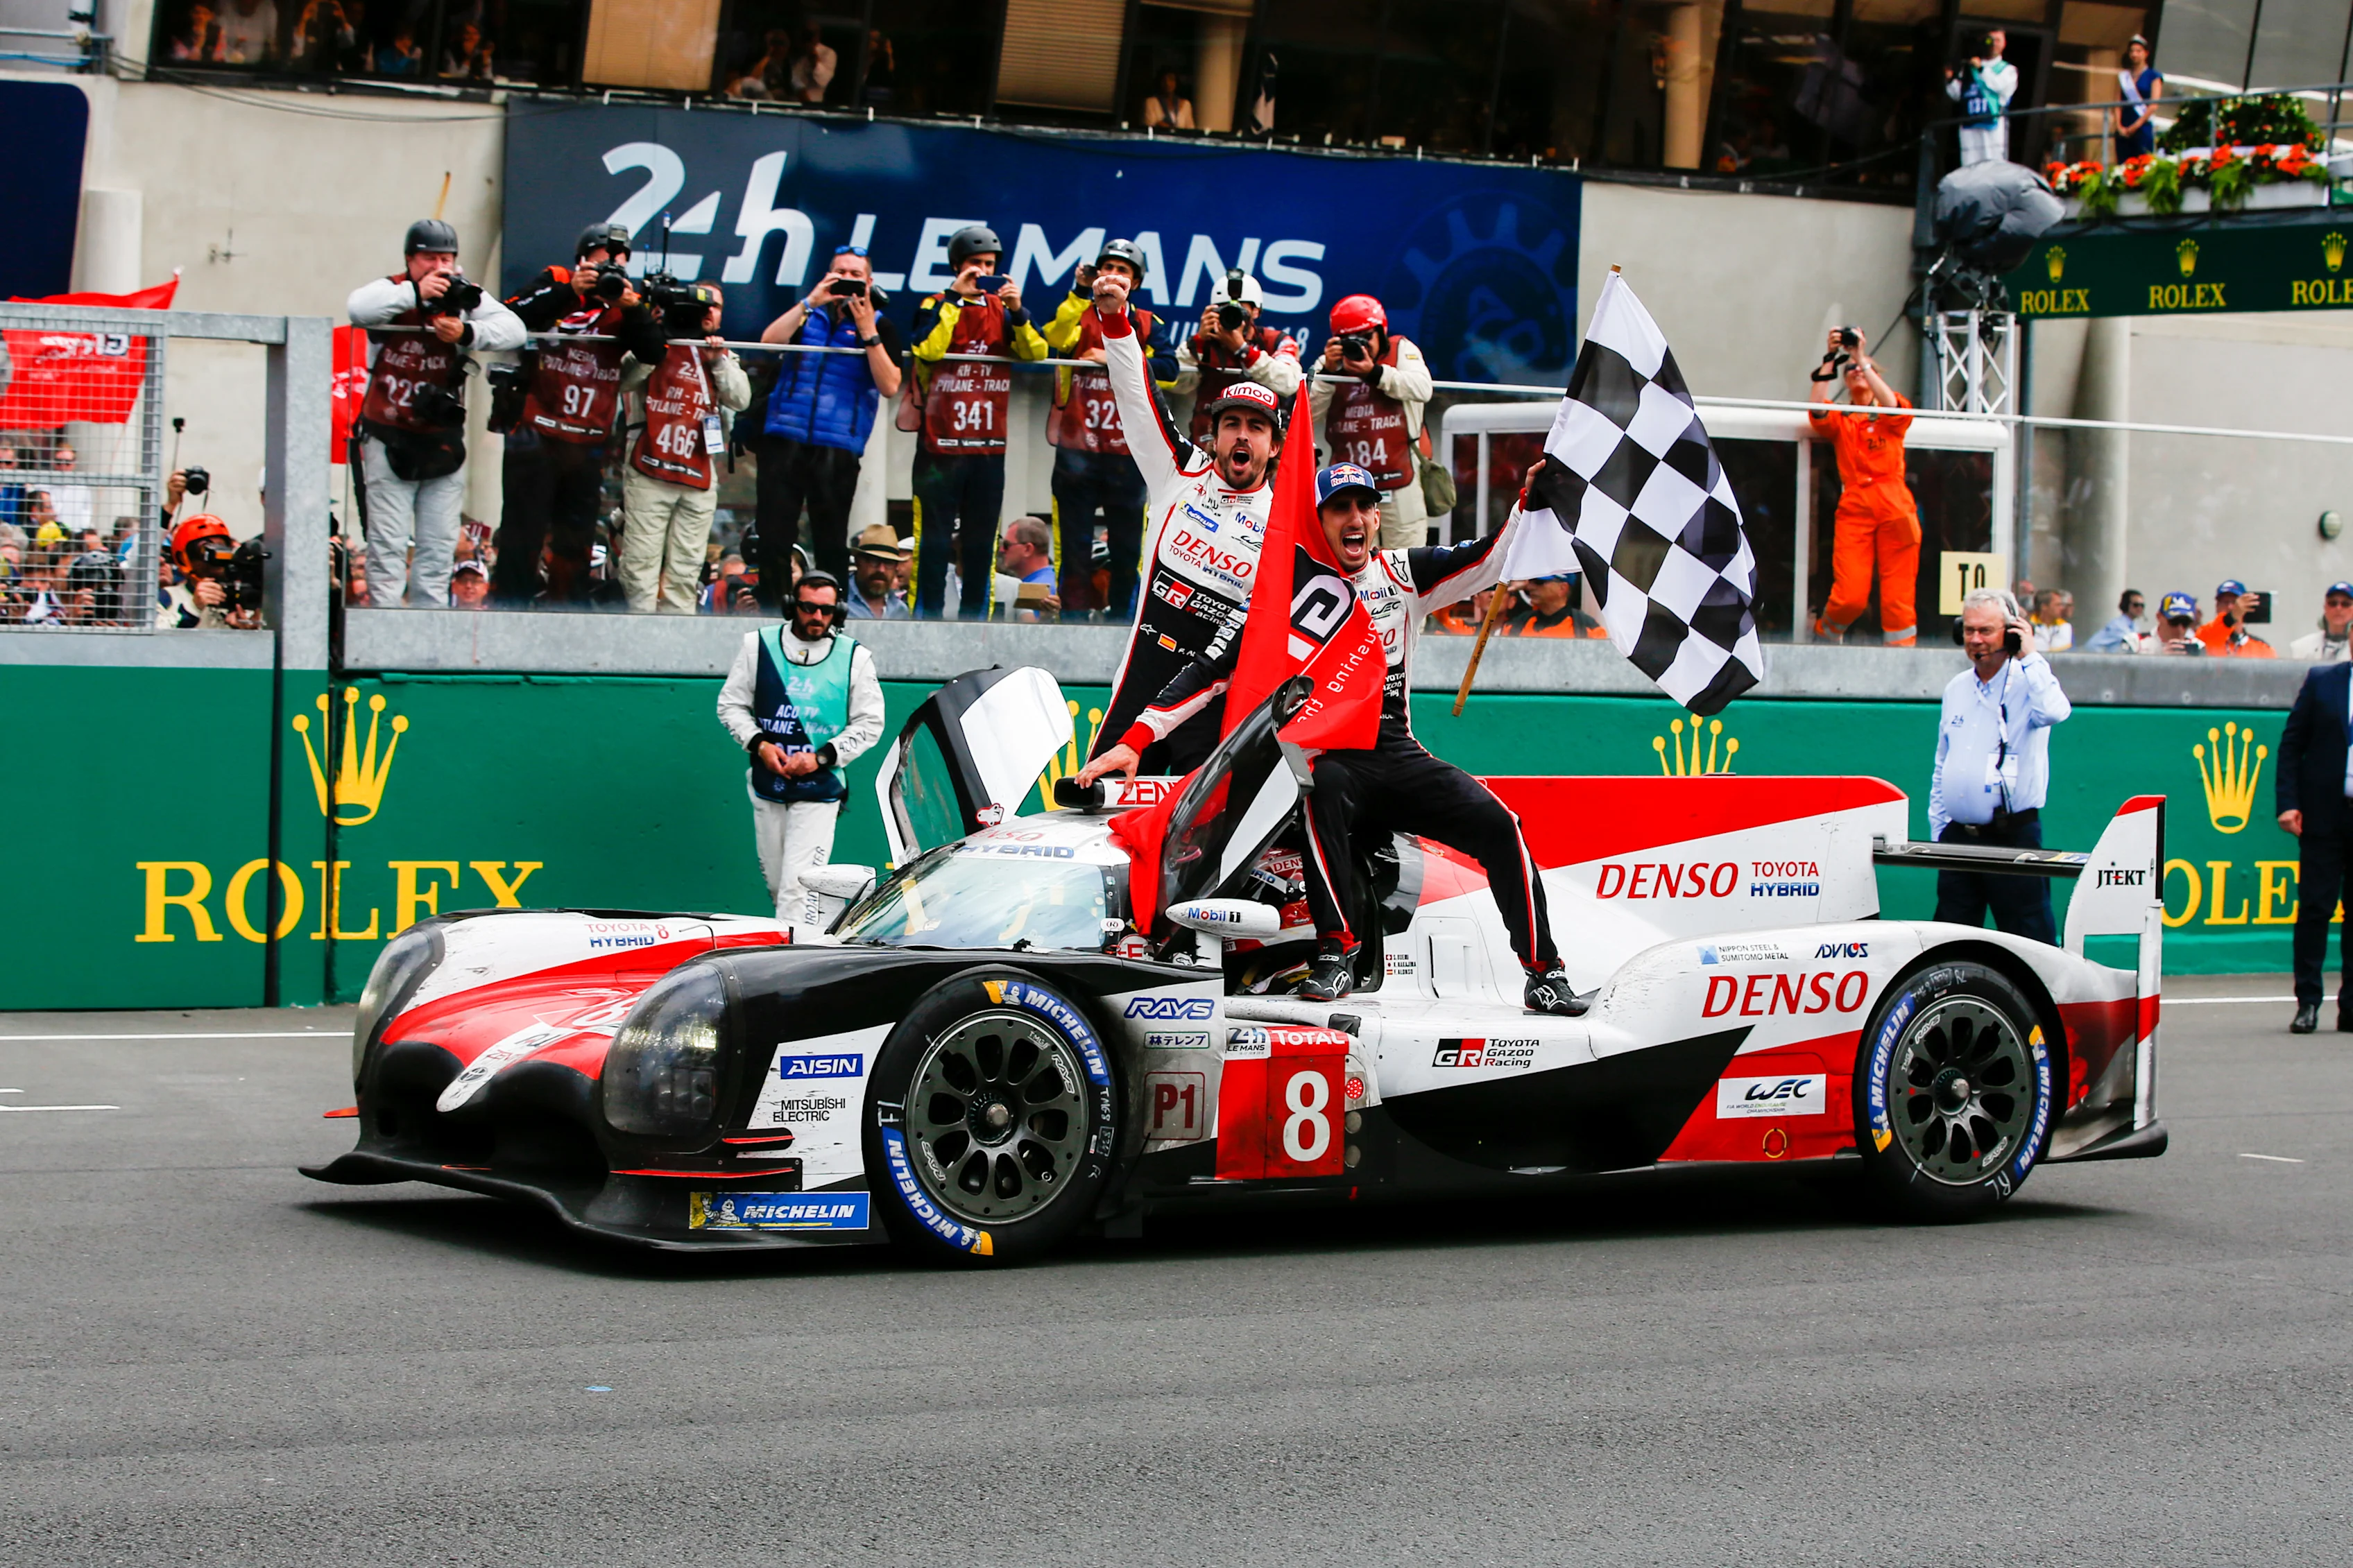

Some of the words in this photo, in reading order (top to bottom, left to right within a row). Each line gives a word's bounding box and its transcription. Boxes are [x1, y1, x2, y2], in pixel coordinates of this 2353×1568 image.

[603, 142, 814, 286] 24h
[2020, 288, 2090, 314] ROLEX
[2149, 283, 2227, 309] ROLEX
[385, 374, 428, 408] 22
[563, 384, 596, 417] 97
[1222, 385, 1273, 404] kimoa
[953, 400, 994, 431] 341
[1084, 399, 1123, 431] 32
[1344, 404, 1375, 419] MEDIA
[1370, 415, 1402, 431] TRACK
[656, 422, 699, 460] 466
[1344, 438, 1388, 469] 184
[1330, 475, 1349, 488] Red
[1349, 473, 1368, 486] Bull
[1172, 529, 1253, 578] DENSO
[1169, 544, 1201, 569] TOYOTA
[1202, 562, 1244, 589] HYBRID
[1153, 580, 1188, 609] GR
[1371, 601, 1401, 616] WEC
[776, 705, 800, 718] ACO
[804, 706, 819, 718] TV
[957, 844, 1075, 859] HYBRID
[1596, 862, 1739, 899] DENSO
[1752, 861, 1820, 877] TOYOTA
[1751, 882, 1820, 897] HYBRID
[2096, 870, 2146, 890] JTEKT
[1188, 907, 1226, 922] Mobil
[584, 923, 651, 933] TOYOTA
[656, 924, 669, 940] 8
[590, 934, 655, 948] HYBRID
[1721, 954, 1763, 962] SUMITOMO
[1764, 952, 1789, 960] METAL
[1814, 942, 1868, 958] ADVICS
[1702, 971, 1868, 1018] DENSO
[1124, 997, 1215, 1019] RAYS
[1024, 990, 1105, 1076] MICHELIN
[1149, 1034, 1207, 1046] 林テレンプ
[1272, 1030, 1346, 1046] TOTAL
[1915, 1014, 1941, 1045] RAYS
[1489, 1039, 1539, 1047] TOYOTA
[1434, 1049, 1482, 1067] GR
[1487, 1048, 1534, 1057] GAZOO
[1484, 1058, 1531, 1069] Racing
[1872, 1002, 1910, 1108] MICHELIN
[787, 1058, 857, 1076] AISIN
[1051, 1053, 1075, 1095] RAYS
[1745, 1079, 1813, 1101] WEC
[781, 1098, 846, 1111] MITSUBISHI
[1153, 1083, 1195, 1129] P1
[773, 1110, 830, 1123] ELECTRIC
[1283, 1070, 1331, 1162] 8
[2020, 1065, 2051, 1171] MICHELIN
[921, 1141, 946, 1182] RAYS
[887, 1139, 959, 1240] MICHELIN
[744, 1205, 856, 1219] MICHELIN
